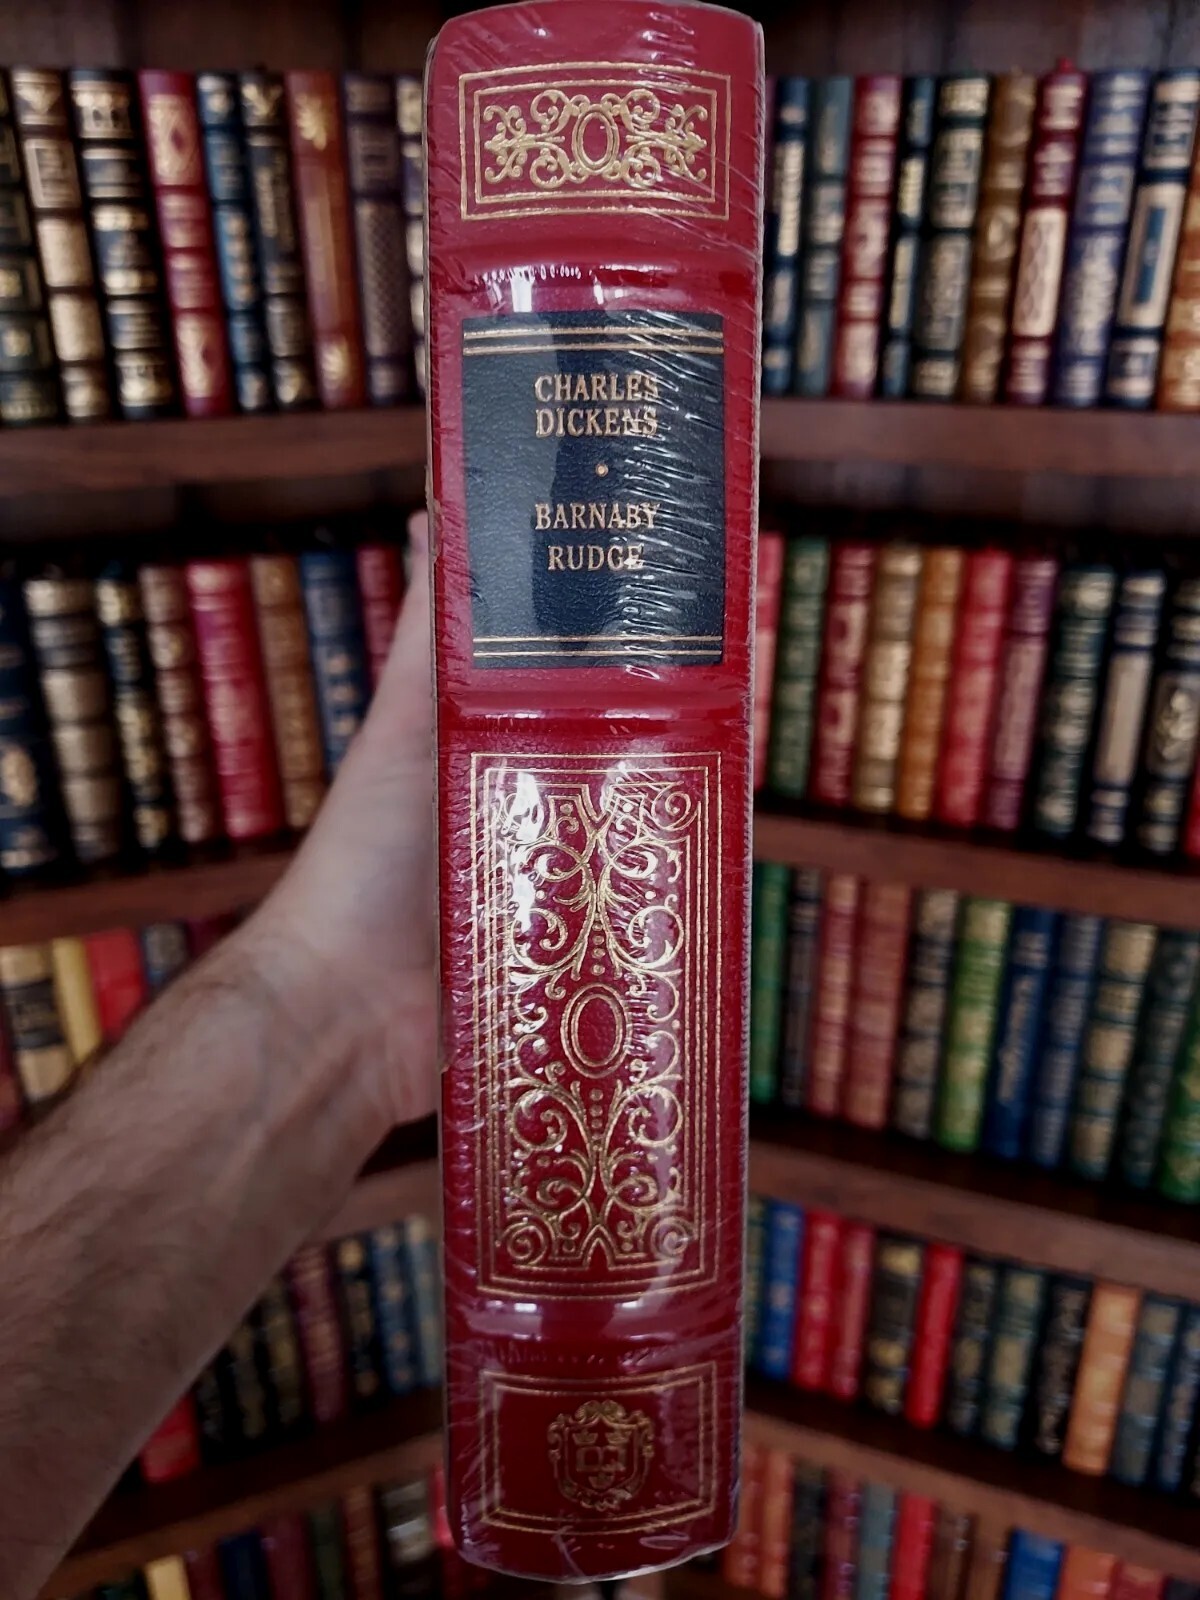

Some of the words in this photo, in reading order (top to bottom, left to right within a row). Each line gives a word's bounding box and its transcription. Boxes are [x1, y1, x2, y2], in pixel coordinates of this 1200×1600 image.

[534, 373, 659, 402] CHARLES
[535, 407, 659, 438] DICKENS
[534, 503, 660, 531] BARNABY
[547, 544, 645, 571] RUDGE
